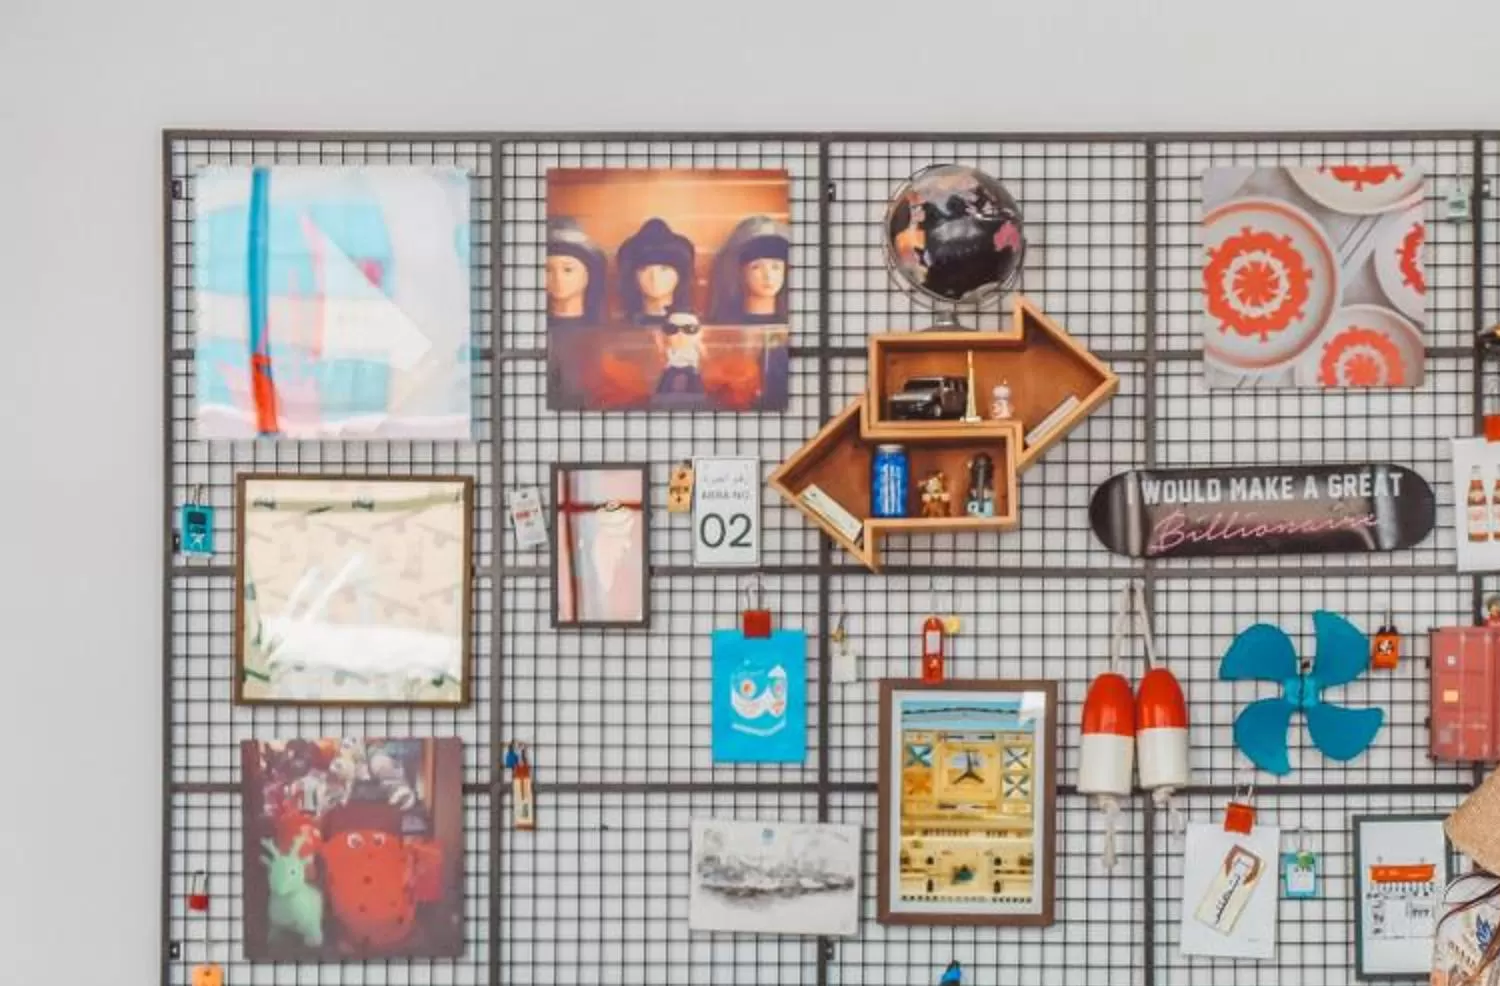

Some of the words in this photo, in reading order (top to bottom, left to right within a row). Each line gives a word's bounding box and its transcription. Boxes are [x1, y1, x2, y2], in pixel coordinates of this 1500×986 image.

[1141, 478, 1221, 505] WOULD
[1229, 475, 1295, 502] MAKE
[1303, 474, 1319, 499] A
[1327, 472, 1404, 499] GREAT
[700, 512, 752, 548] 02
